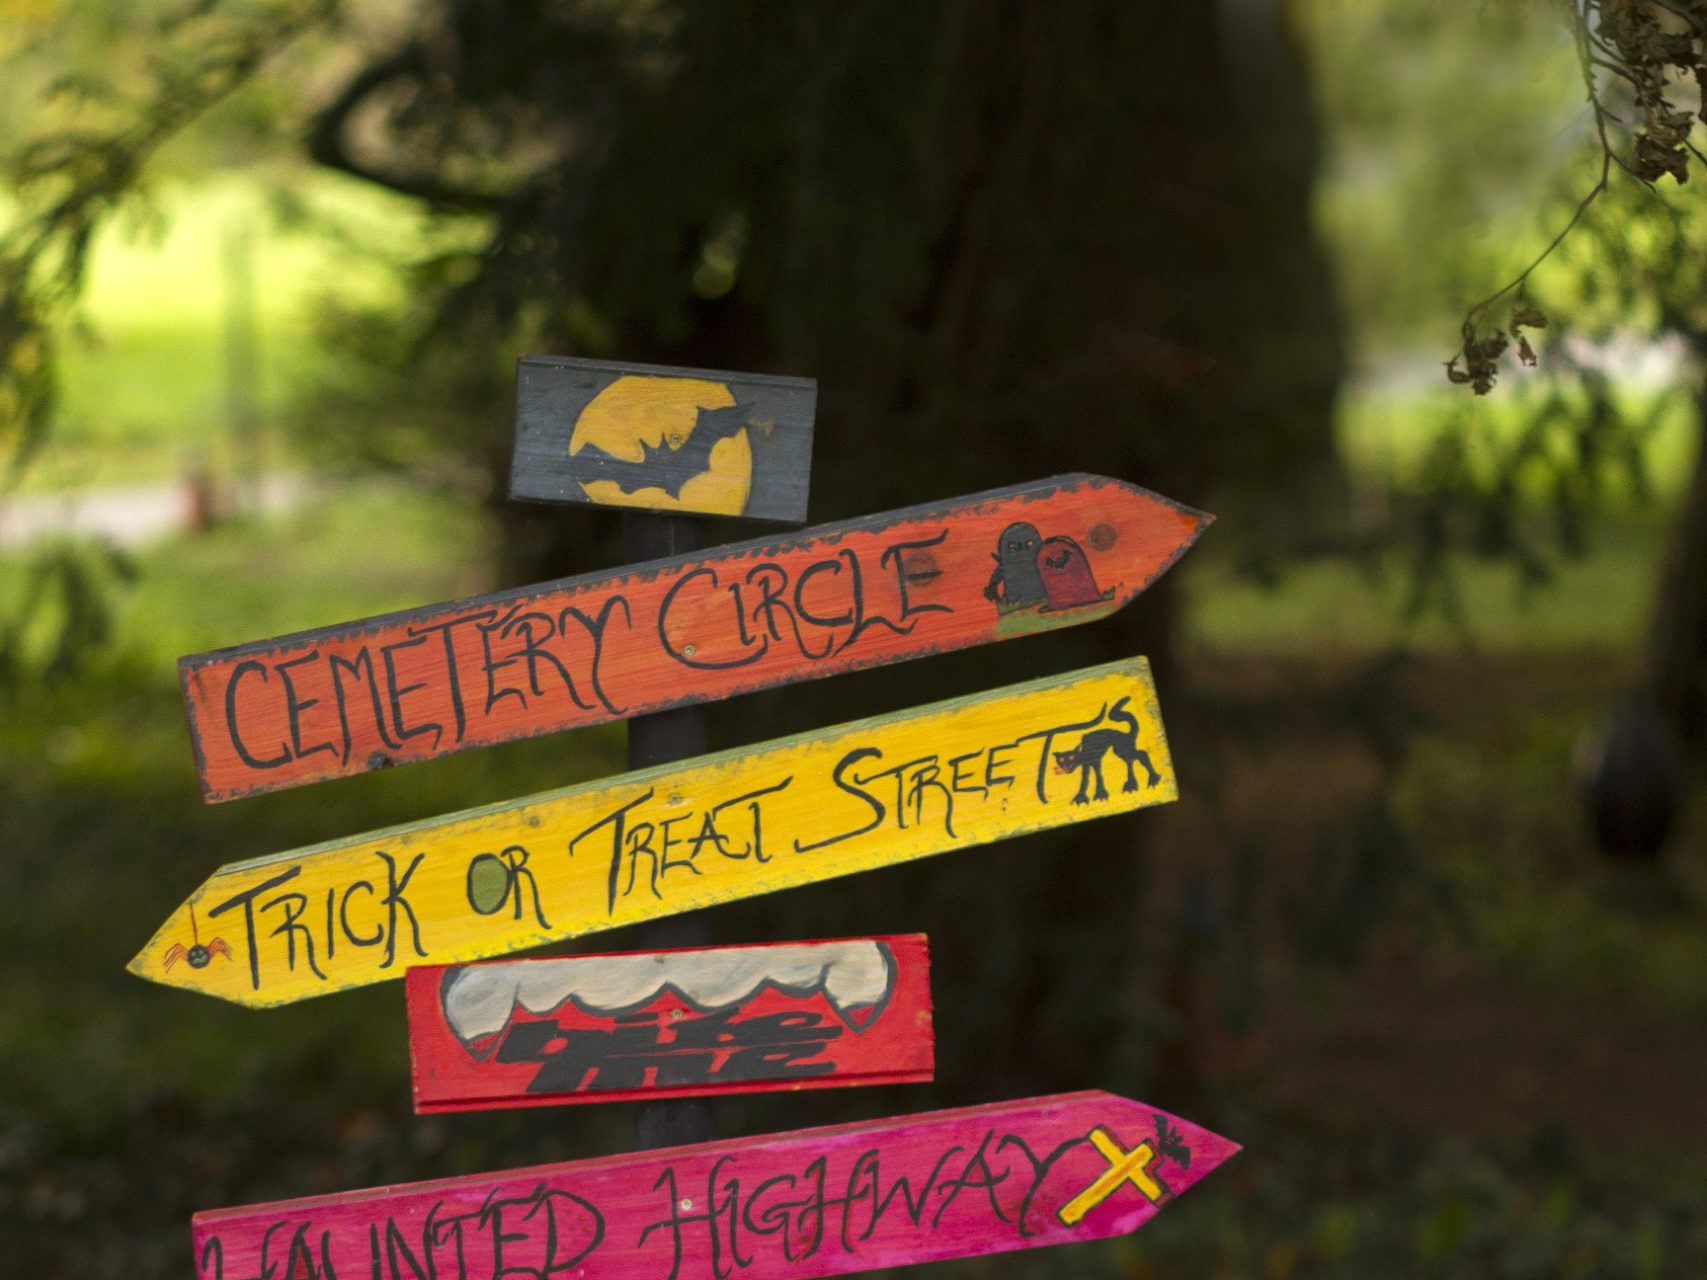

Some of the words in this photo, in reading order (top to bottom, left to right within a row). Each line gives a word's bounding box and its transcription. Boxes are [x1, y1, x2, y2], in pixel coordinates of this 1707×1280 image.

[225, 594, 631, 770] CEMETERY
[658, 529, 954, 671] CIRCLE
[209, 851, 428, 991] TRICK
[466, 845, 552, 930] OR
[569, 776, 794, 917] TREAT
[794, 702, 1107, 854] STREET
[495, 1008, 844, 1065] bite
[526, 1042, 838, 1094] me
